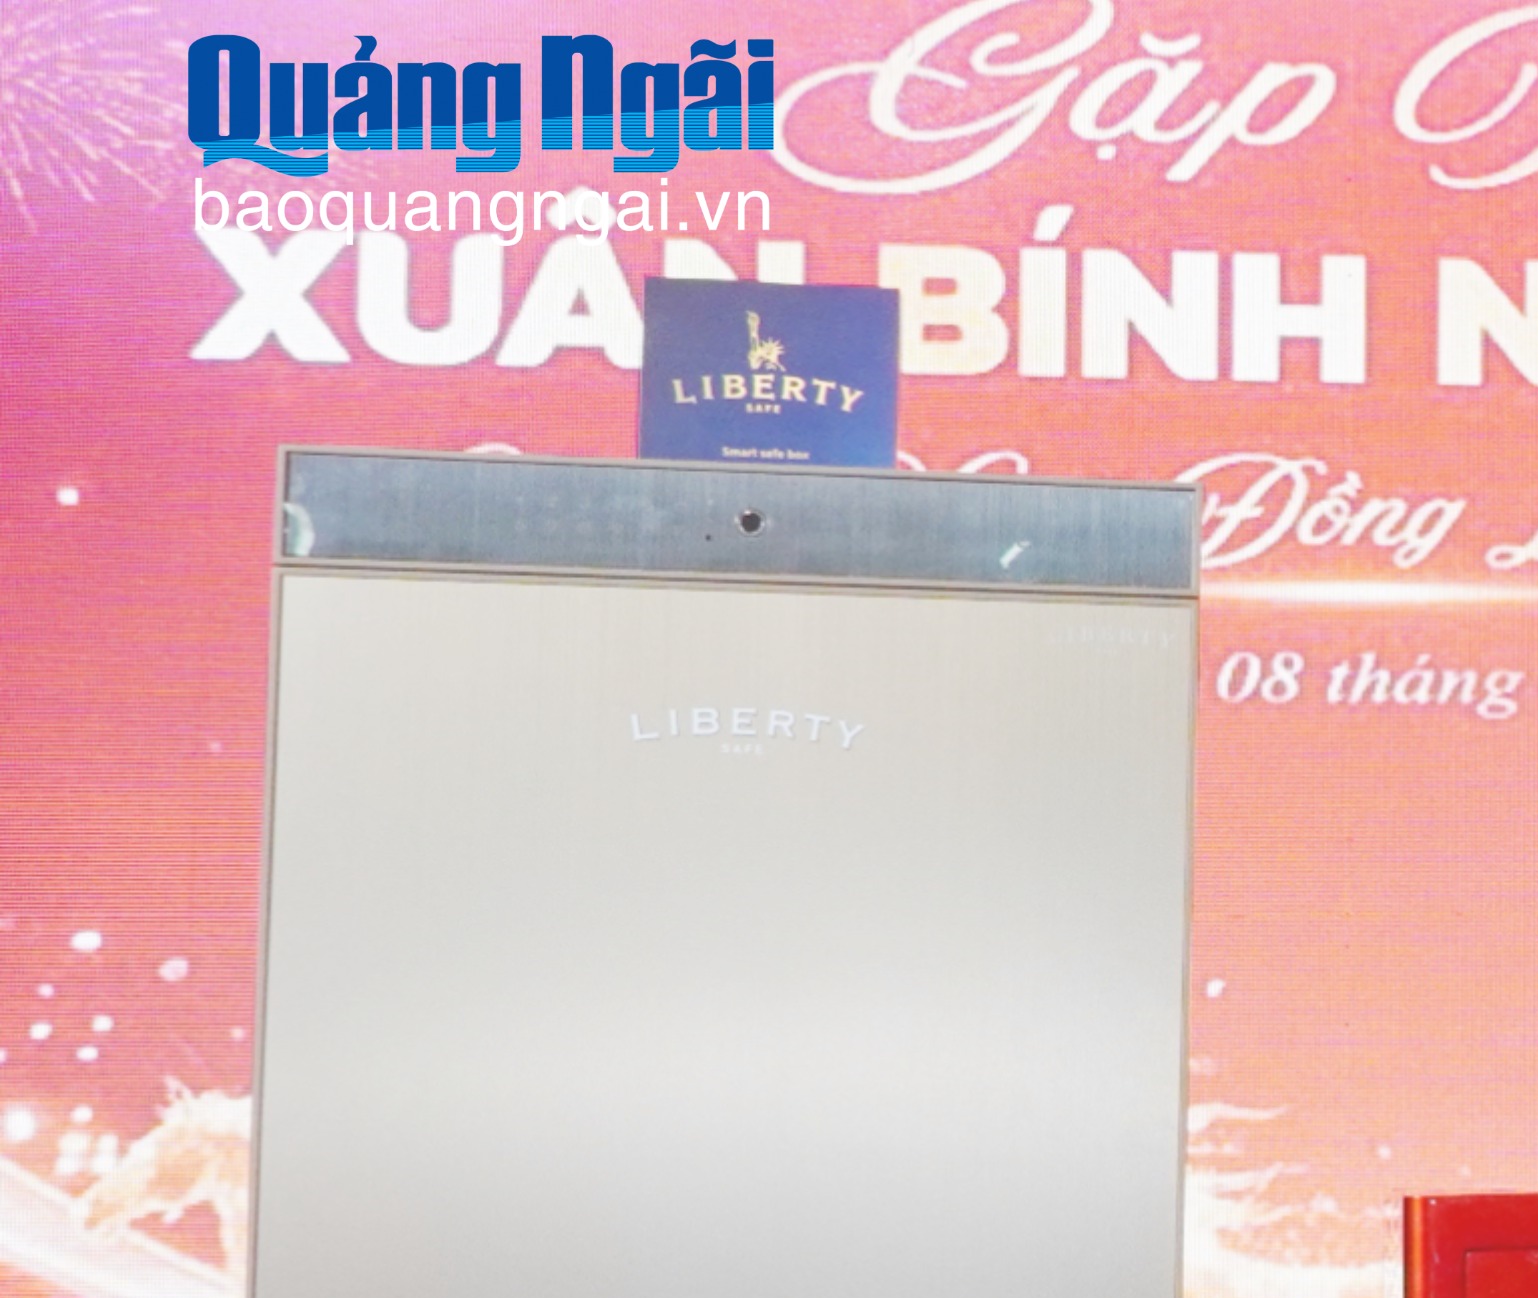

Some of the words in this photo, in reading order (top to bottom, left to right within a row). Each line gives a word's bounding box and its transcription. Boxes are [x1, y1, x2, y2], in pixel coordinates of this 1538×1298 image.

[773, 0, 1337, 194] Gặp
[190, 186, 805, 369] XUÂ
[878, 205, 1366, 385] BÍNH
[672, 373, 865, 413] LIBERTY
[745, 403, 781, 414] SAFE
[721, 446, 758, 458] Smart
[760, 447, 785, 459] safe
[787, 448, 810, 460] box
[1172, 452, 1468, 569] Đồng
[1215, 650, 1304, 704] 08
[1326, 651, 1525, 720] tháng
[630, 706, 864, 750] LIBERTY
[720, 743, 765, 755] SAFE
